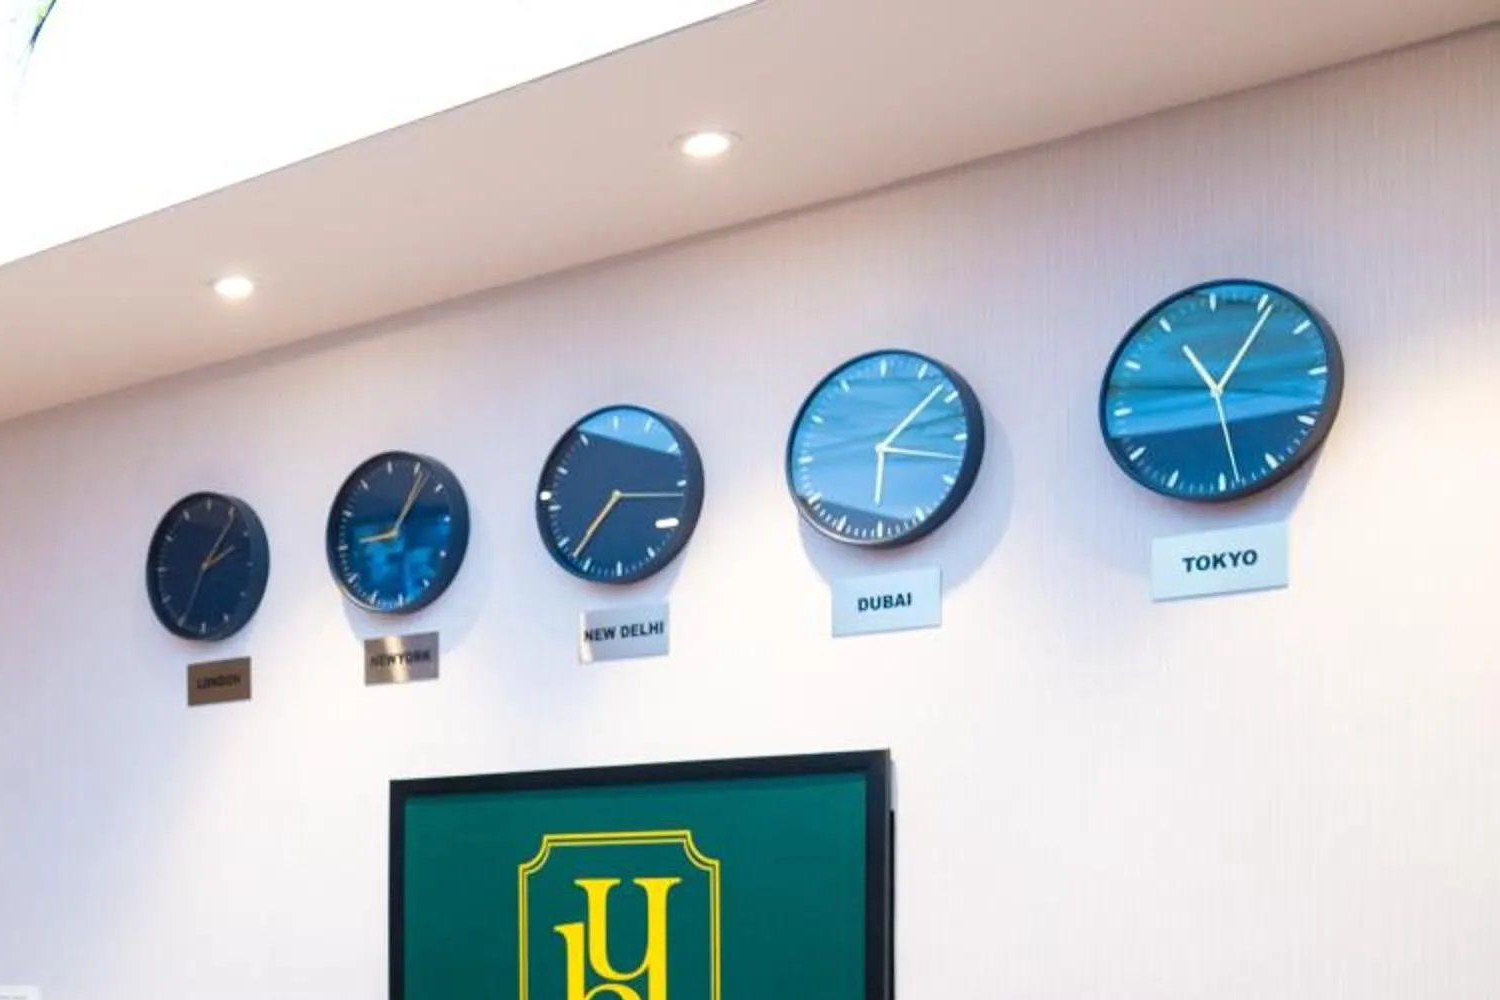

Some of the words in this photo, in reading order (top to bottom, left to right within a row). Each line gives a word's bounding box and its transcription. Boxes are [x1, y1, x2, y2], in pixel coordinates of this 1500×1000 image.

[1181, 549, 1258, 573] TOKYO
[857, 592, 912, 612] DUBAI
[584, 626, 617, 641] NEW
[620, 620, 665, 639] DELHI
